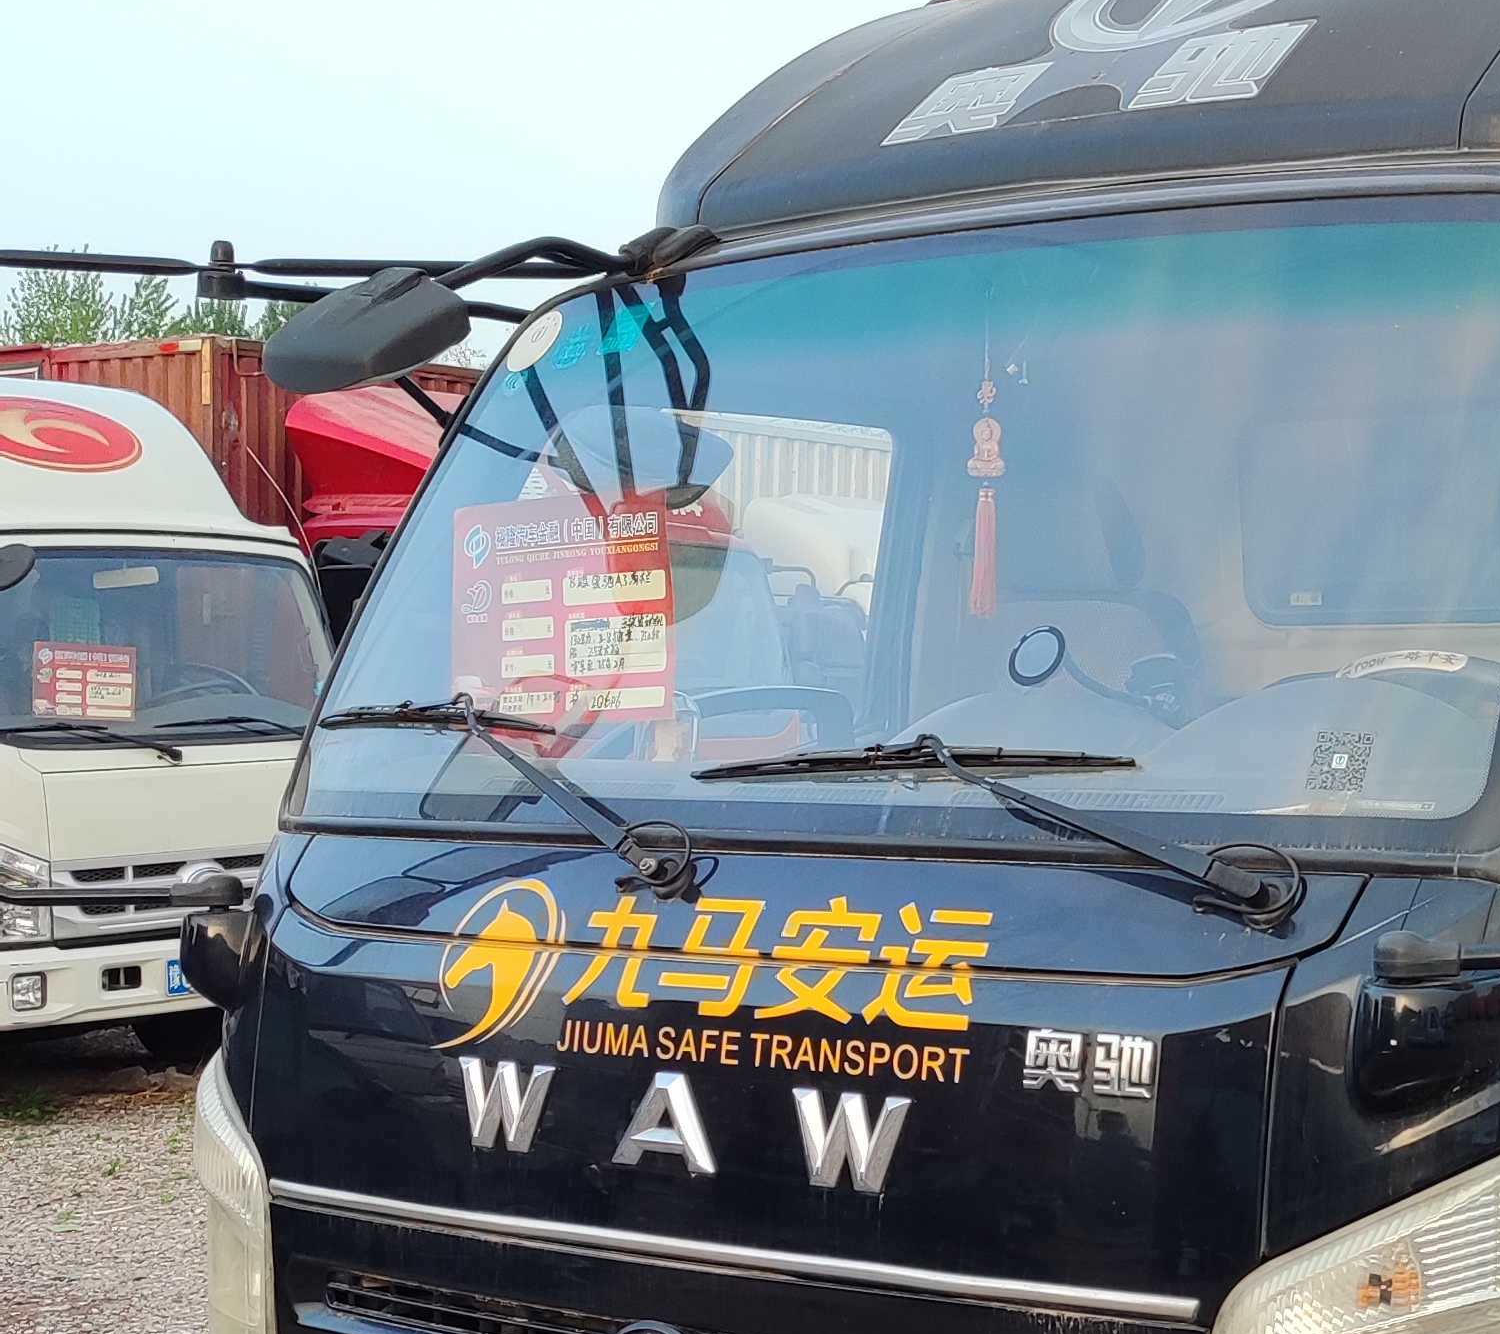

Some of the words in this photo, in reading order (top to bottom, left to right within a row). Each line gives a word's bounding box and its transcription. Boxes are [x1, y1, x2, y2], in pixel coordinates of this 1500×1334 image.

[526, 551, 551, 564] QICHE
[552, 548, 588, 560] JINRONG
[560, 893, 994, 1031] 九马安运
[556, 1018, 650, 1059] JIUMA
[655, 1024, 742, 1066] SAFE
[752, 1031, 971, 1084] TRANSPORT
[1022, 1027, 1158, 1101] 奥驰
